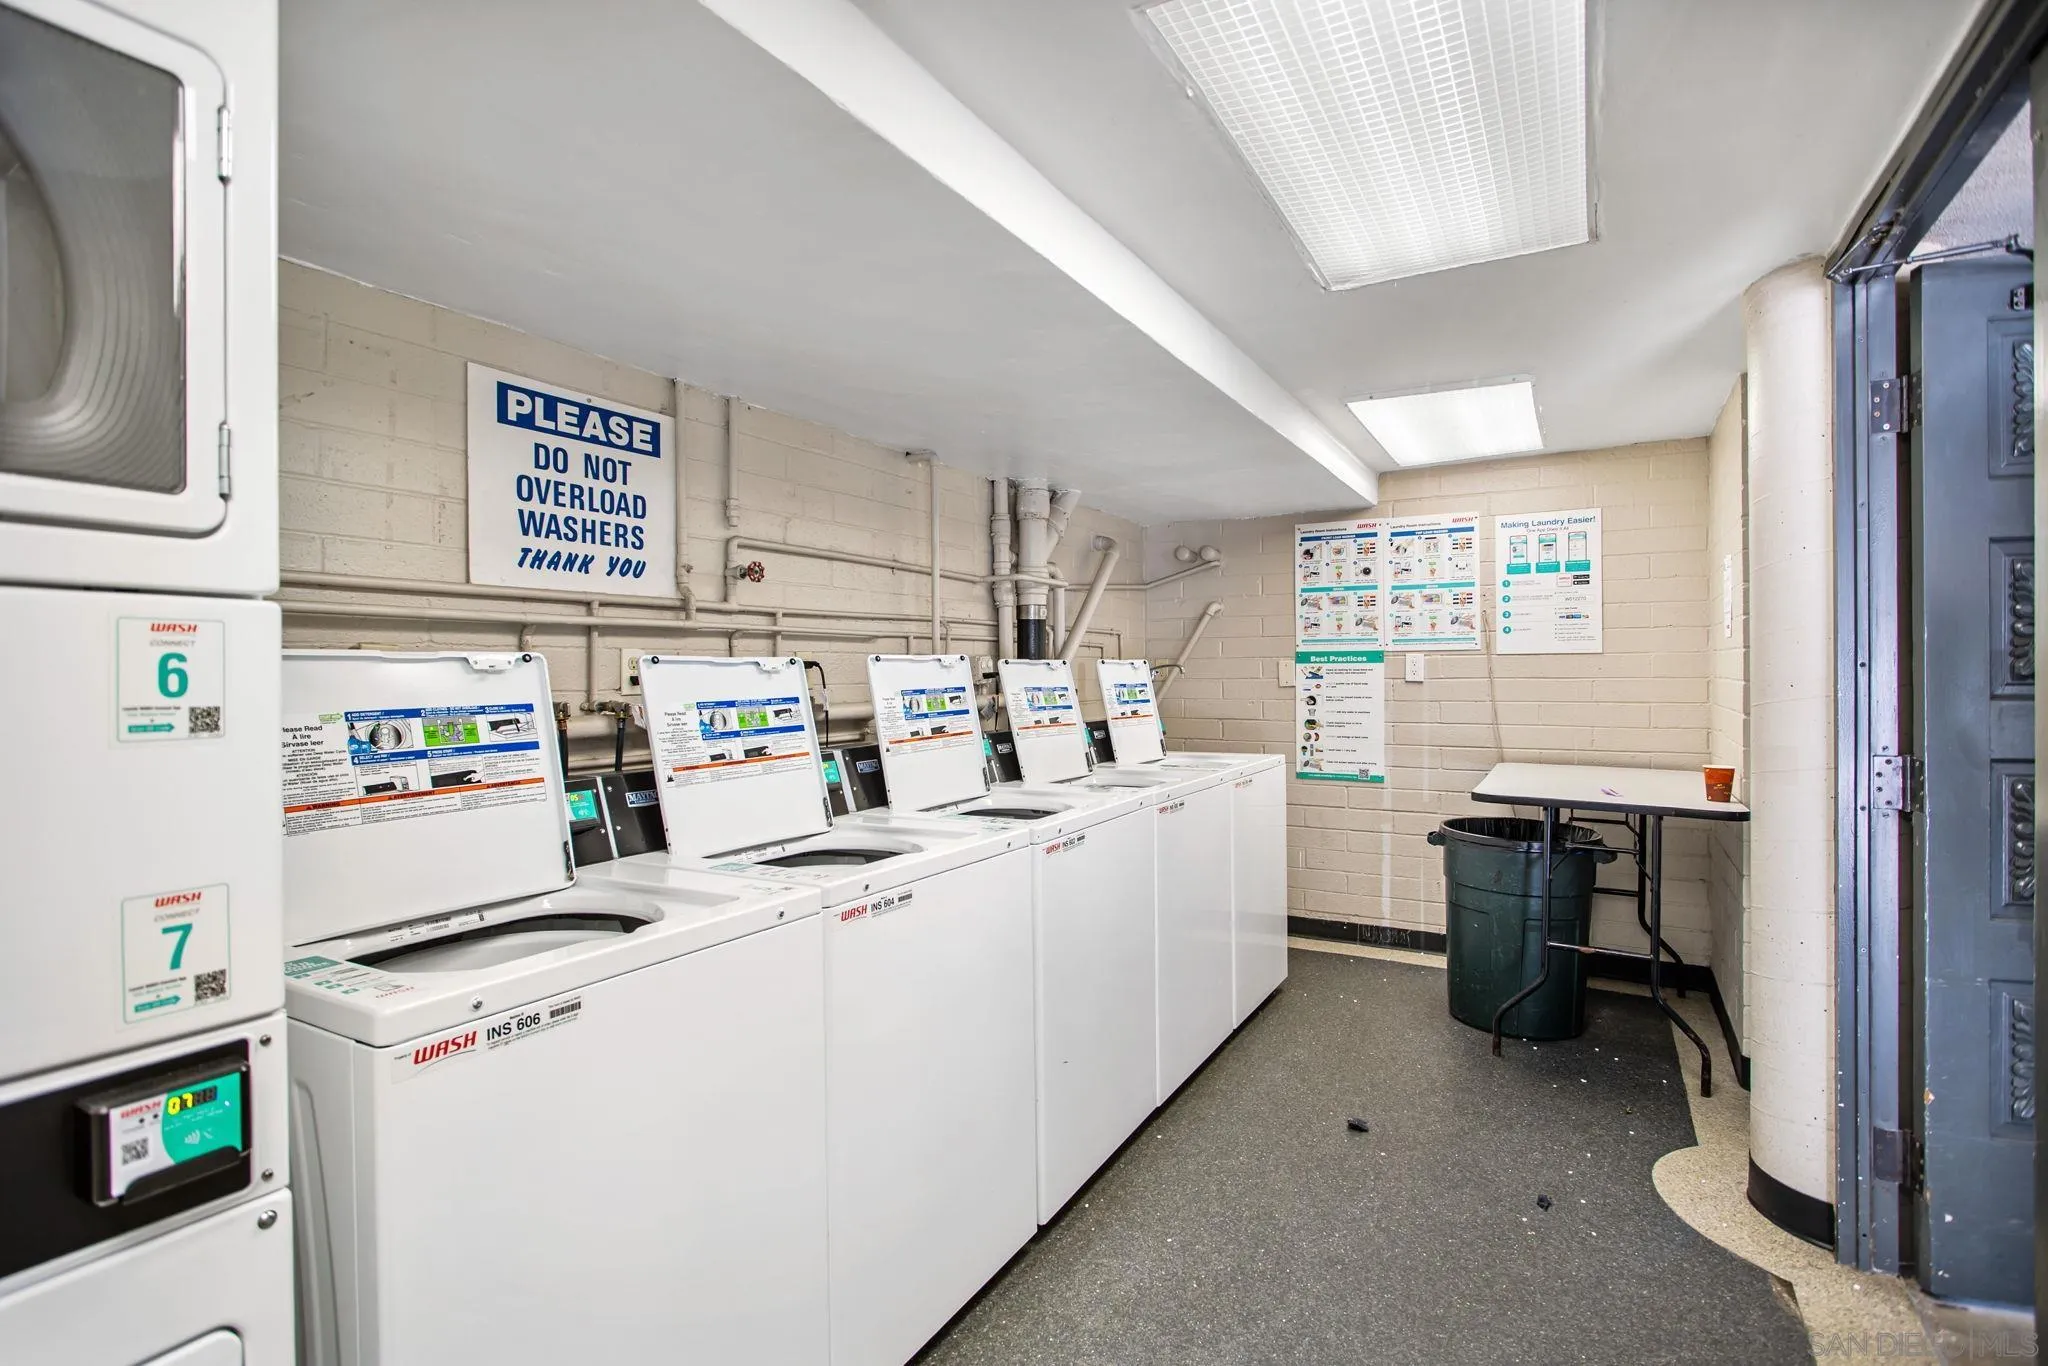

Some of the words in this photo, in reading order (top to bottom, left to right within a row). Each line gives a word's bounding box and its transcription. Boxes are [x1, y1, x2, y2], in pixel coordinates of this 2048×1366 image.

[506, 389, 653, 452] PLEASE
[533, 442, 569, 474] DO
[584, 453, 632, 485] NOT
[516, 474, 647, 520] OVERLOAD
[517, 508, 644, 550] WASHERS
[1501, 521, 1529, 529] Making
[1531, 519, 1565, 527] Laundry
[1567, 515, 1596, 524] Easier!
[517, 547, 595, 575] THANK
[606, 555, 647, 579] YOU
[150, 623, 198, 633] WASH
[158, 652, 189, 699] 6
[1329, 655, 1367, 663] Practices
[628, 790, 658, 801] MAYTA
[155, 891, 202, 908] WASH
[840, 903, 868, 922] WASH
[870, 900, 882, 913] INS
[883, 897, 895, 908] 604
[161, 922, 193, 971] 7
[413, 1030, 477, 1065] WASH
[486, 1022, 512, 1042] INS
[516, 1012, 541, 1031] 606
